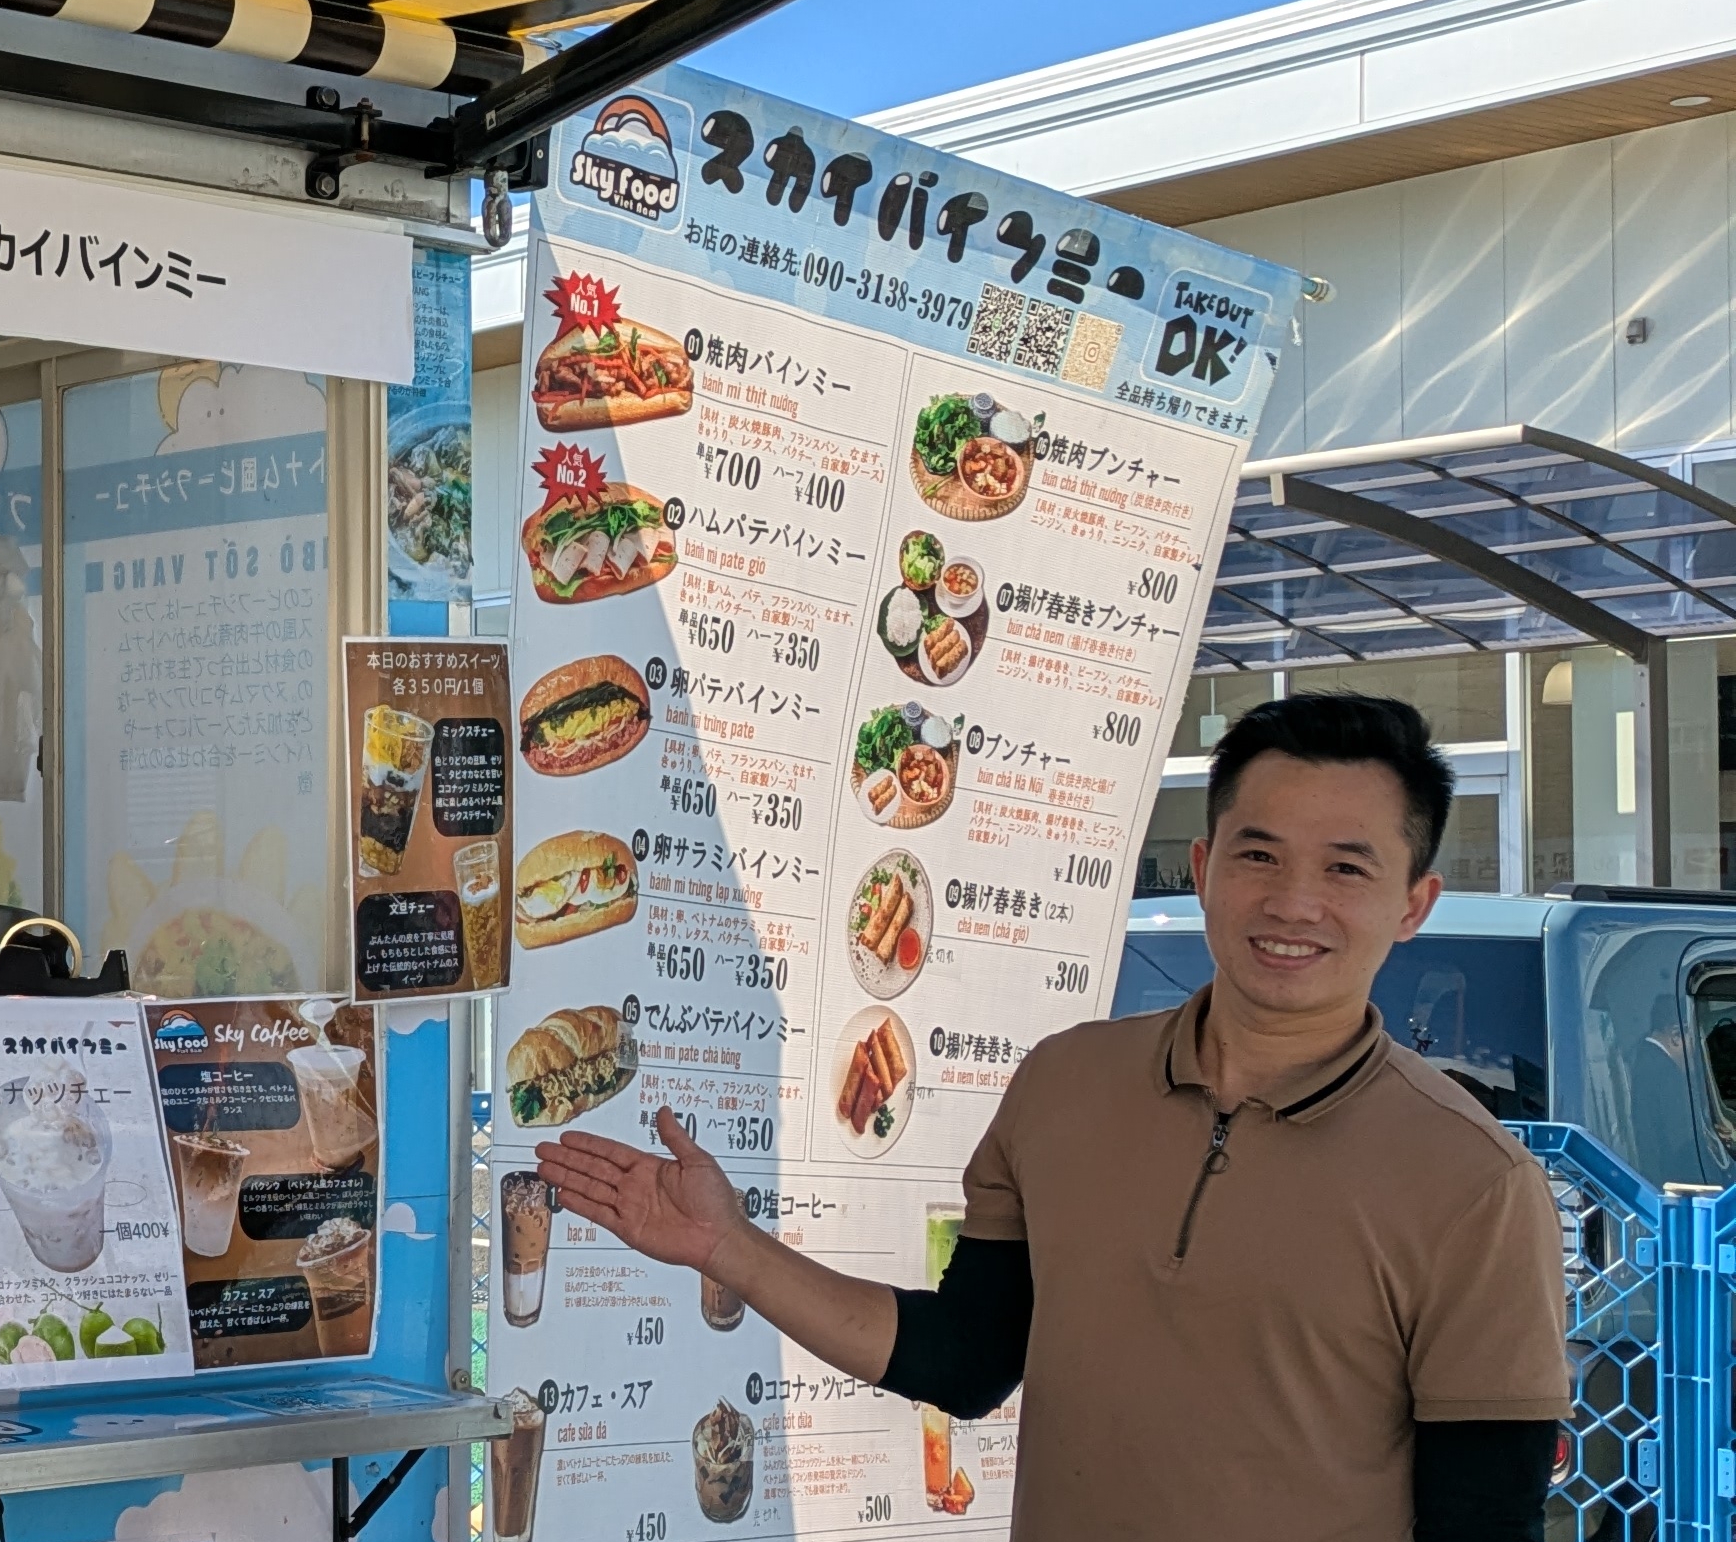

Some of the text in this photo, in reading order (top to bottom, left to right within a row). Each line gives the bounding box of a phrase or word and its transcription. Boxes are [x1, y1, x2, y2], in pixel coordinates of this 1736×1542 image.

[572, 153, 679, 211] Sky Food
[613, 188, 634, 211] Viet
[701, 110, 1145, 304] スカイバインミー
[570, 293, 599, 319] No.1
[575, 281, 598, 299] 人気
[705, 335, 852, 396] 焼肉バインミー
[1114, 380, 1249, 436] 全品持ち帰りできます。
[556, 463, 587, 488] No.2
[561, 450, 584, 468] 人気
[1048, 435, 1181, 486] 焼肉ブンチャー
[696, 441, 845, 512] 単品 ¥700 ハーフ ¥400
[689, 506, 866, 566] ハムパテバインミー
[720, 550, 745, 572] pate
[1128, 566, 1179, 605] ¥800
[1014, 585, 1181, 643] 揚げ春巻きブンチャー
[678, 608, 821, 672] 単品 ¥650 ハーフ ¥350
[367, 651, 500, 670] 本日のおすすめスイーツ
[670, 667, 820, 721] 卵パテバインミー
[442, 725, 496, 738] ミックスチェー
[729, 720, 755, 740] pate
[1093, 711, 1142, 747] ¥800
[985, 735, 1071, 771] ブンチャー
[659, 775, 803, 832] 単品 ¥650 ハーフ ¥350
[653, 832, 820, 883] 卵サラミバインミー
[1053, 853, 1113, 890] ¥1000
[389, 901, 435, 915] 文旦チェー
[961, 882, 1043, 921] 揚げ春巻き
[647, 941, 789, 991] 単品 ¥650 ハーフ ¥350
[1045, 961, 1090, 995] ¥300
[214, 1019, 310, 1052] Sky Coffee
[644, 1004, 806, 1043] でんぶパテバインミー
[2, 1036, 128, 1056] スカイバインミー
[154, 1037, 175, 1053] Sky
[177, 1035, 209, 1049] Food
[678, 1046, 700, 1065] pate
[945, 1031, 1014, 1066] 揚げ春巻き
[200, 1069, 254, 1084] 塩コーヒー
[707, 1116, 774, 1151] ハーフ ¥350
[761, 1189, 838, 1221] 塩コーヒー
[223, 1287, 276, 1302] カフェ・スア
[627, 1316, 664, 1347] ¥450
[559, 1379, 653, 1415] カフェ・スア
[558, 1425, 575, 1444] cafe
[857, 1494, 892, 1524] ¥500
[626, 1512, 667, 1542] ¥450
